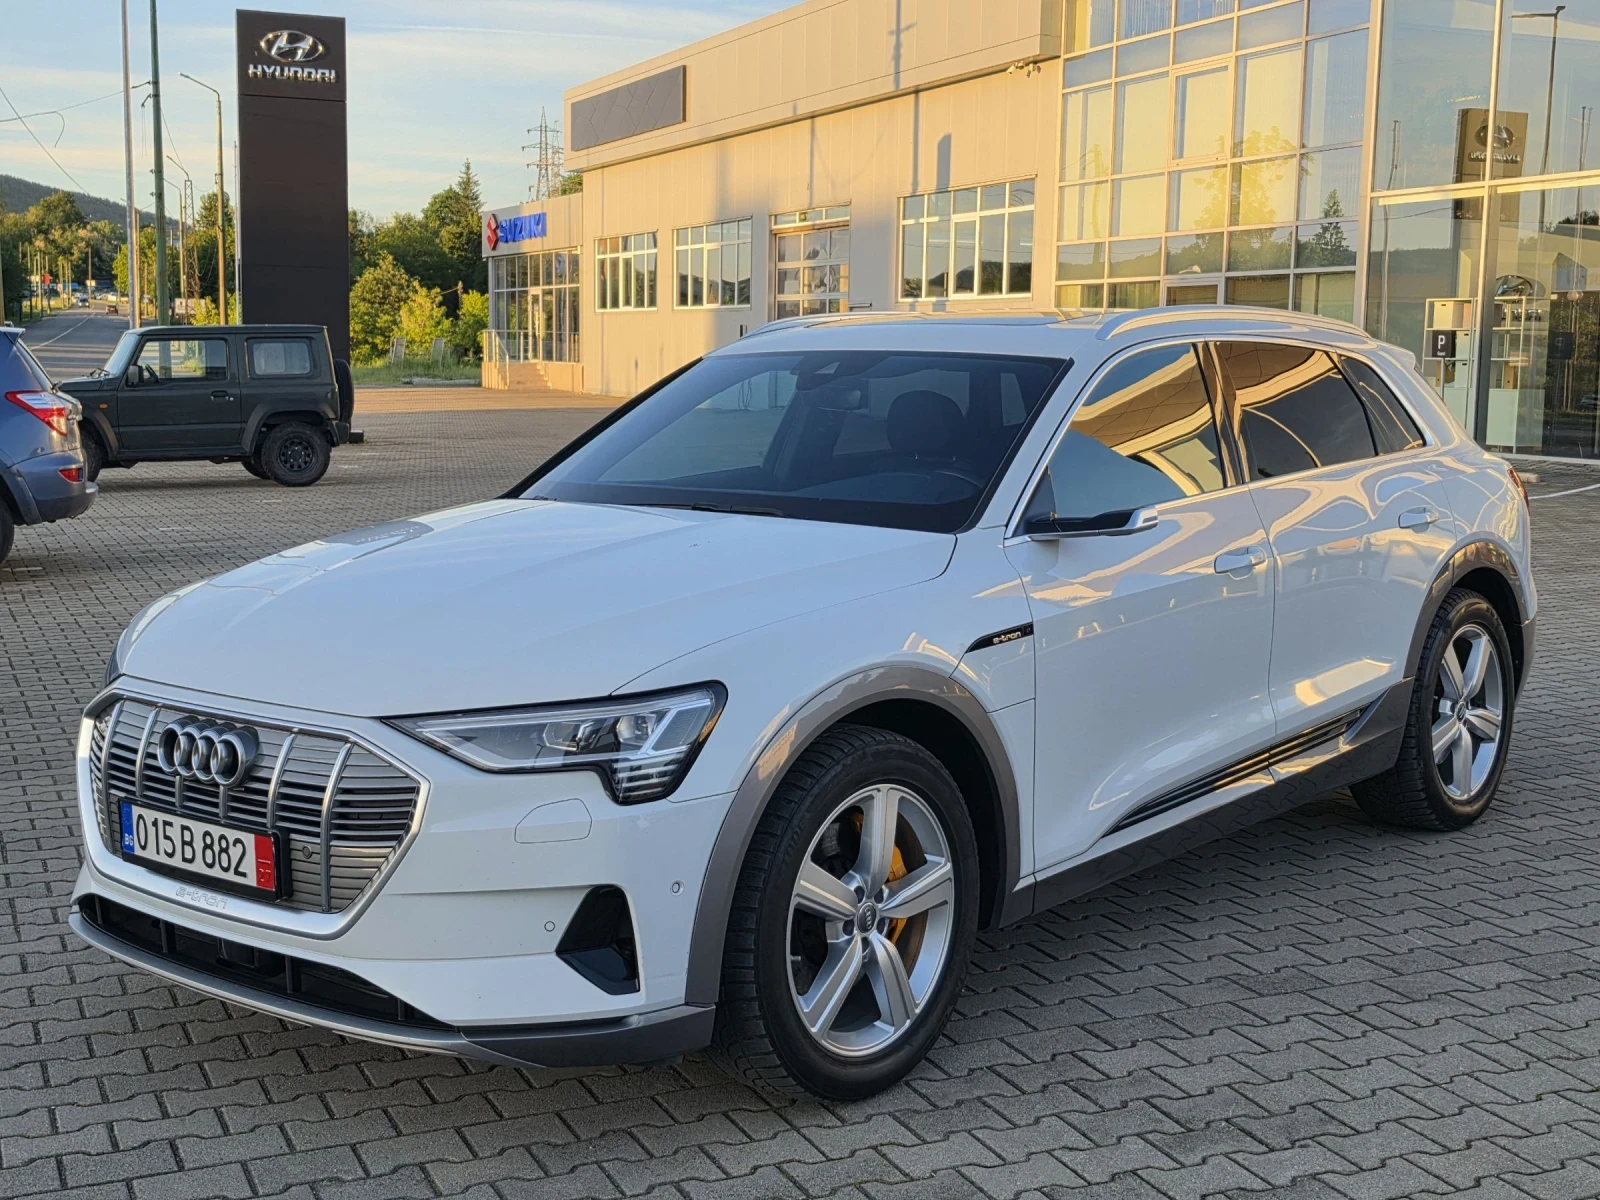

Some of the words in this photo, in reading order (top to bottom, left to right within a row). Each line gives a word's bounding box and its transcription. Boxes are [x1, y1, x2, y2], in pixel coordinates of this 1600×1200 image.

[248, 64, 336, 83] HYUNDAI
[499, 212, 547, 244] SUZUKI
[1437, 334, 1446, 350] P
[993, 631, 1022, 644] e-tron
[124, 833, 134, 846] BG
[175, 886, 228, 909] e-tron
